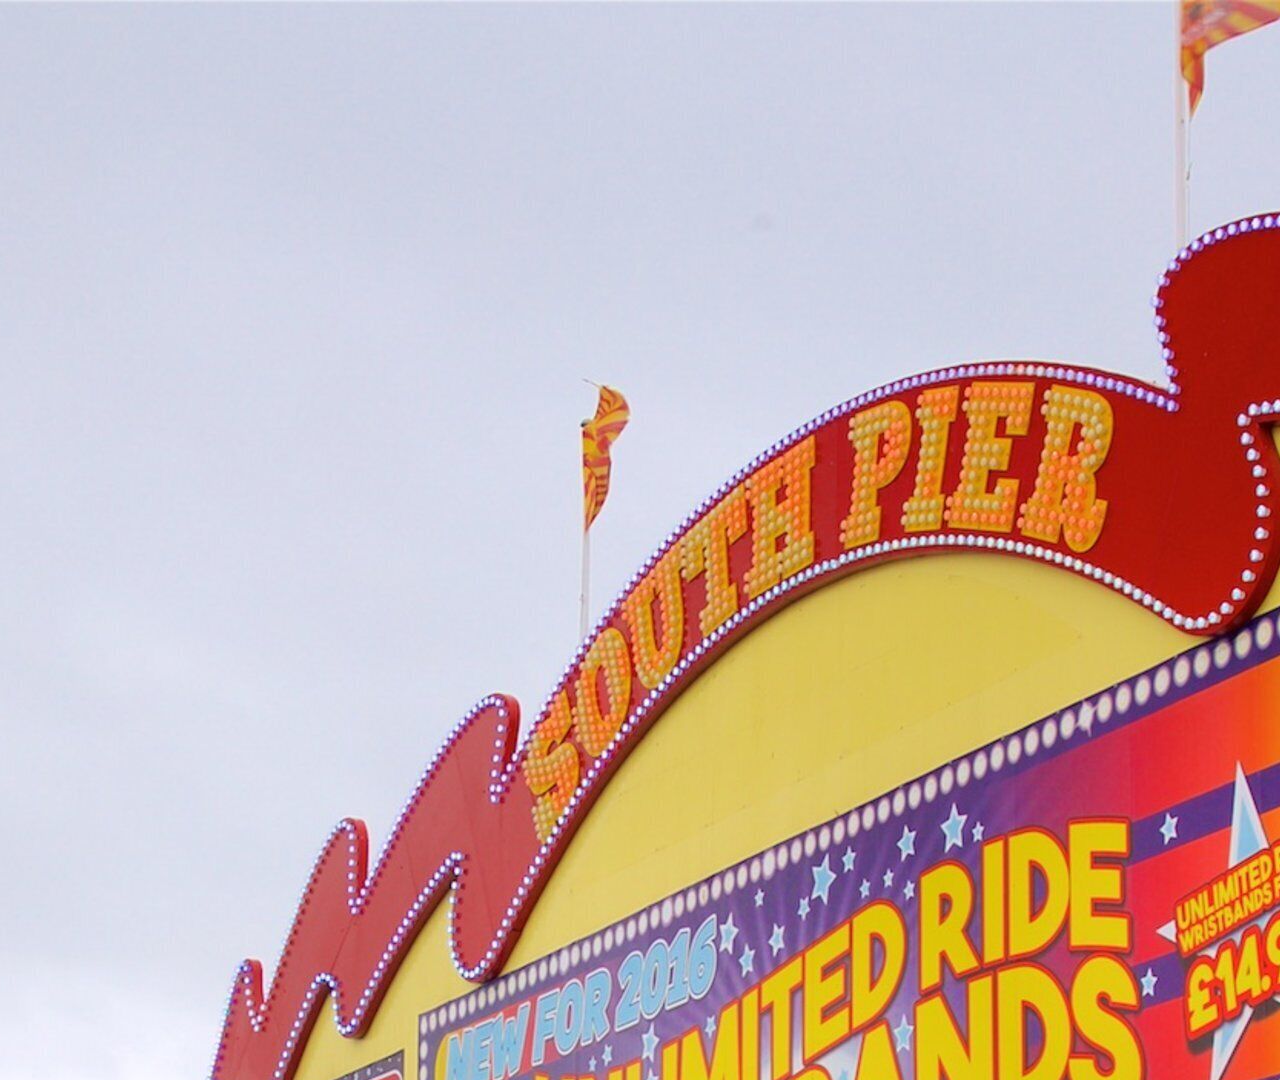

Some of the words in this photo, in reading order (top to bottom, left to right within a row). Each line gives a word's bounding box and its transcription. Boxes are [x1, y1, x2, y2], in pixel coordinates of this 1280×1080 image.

[523, 436, 816, 843] SOUTH
[840, 381, 1114, 552] PIER
[919, 818, 1130, 992] RIDE
[1177, 853, 1272, 930] UNLIMITED
[1179, 883, 1272, 951] WRISTBANDS
[532, 979, 609, 1064] FOR
[615, 914, 719, 1033] 2016
